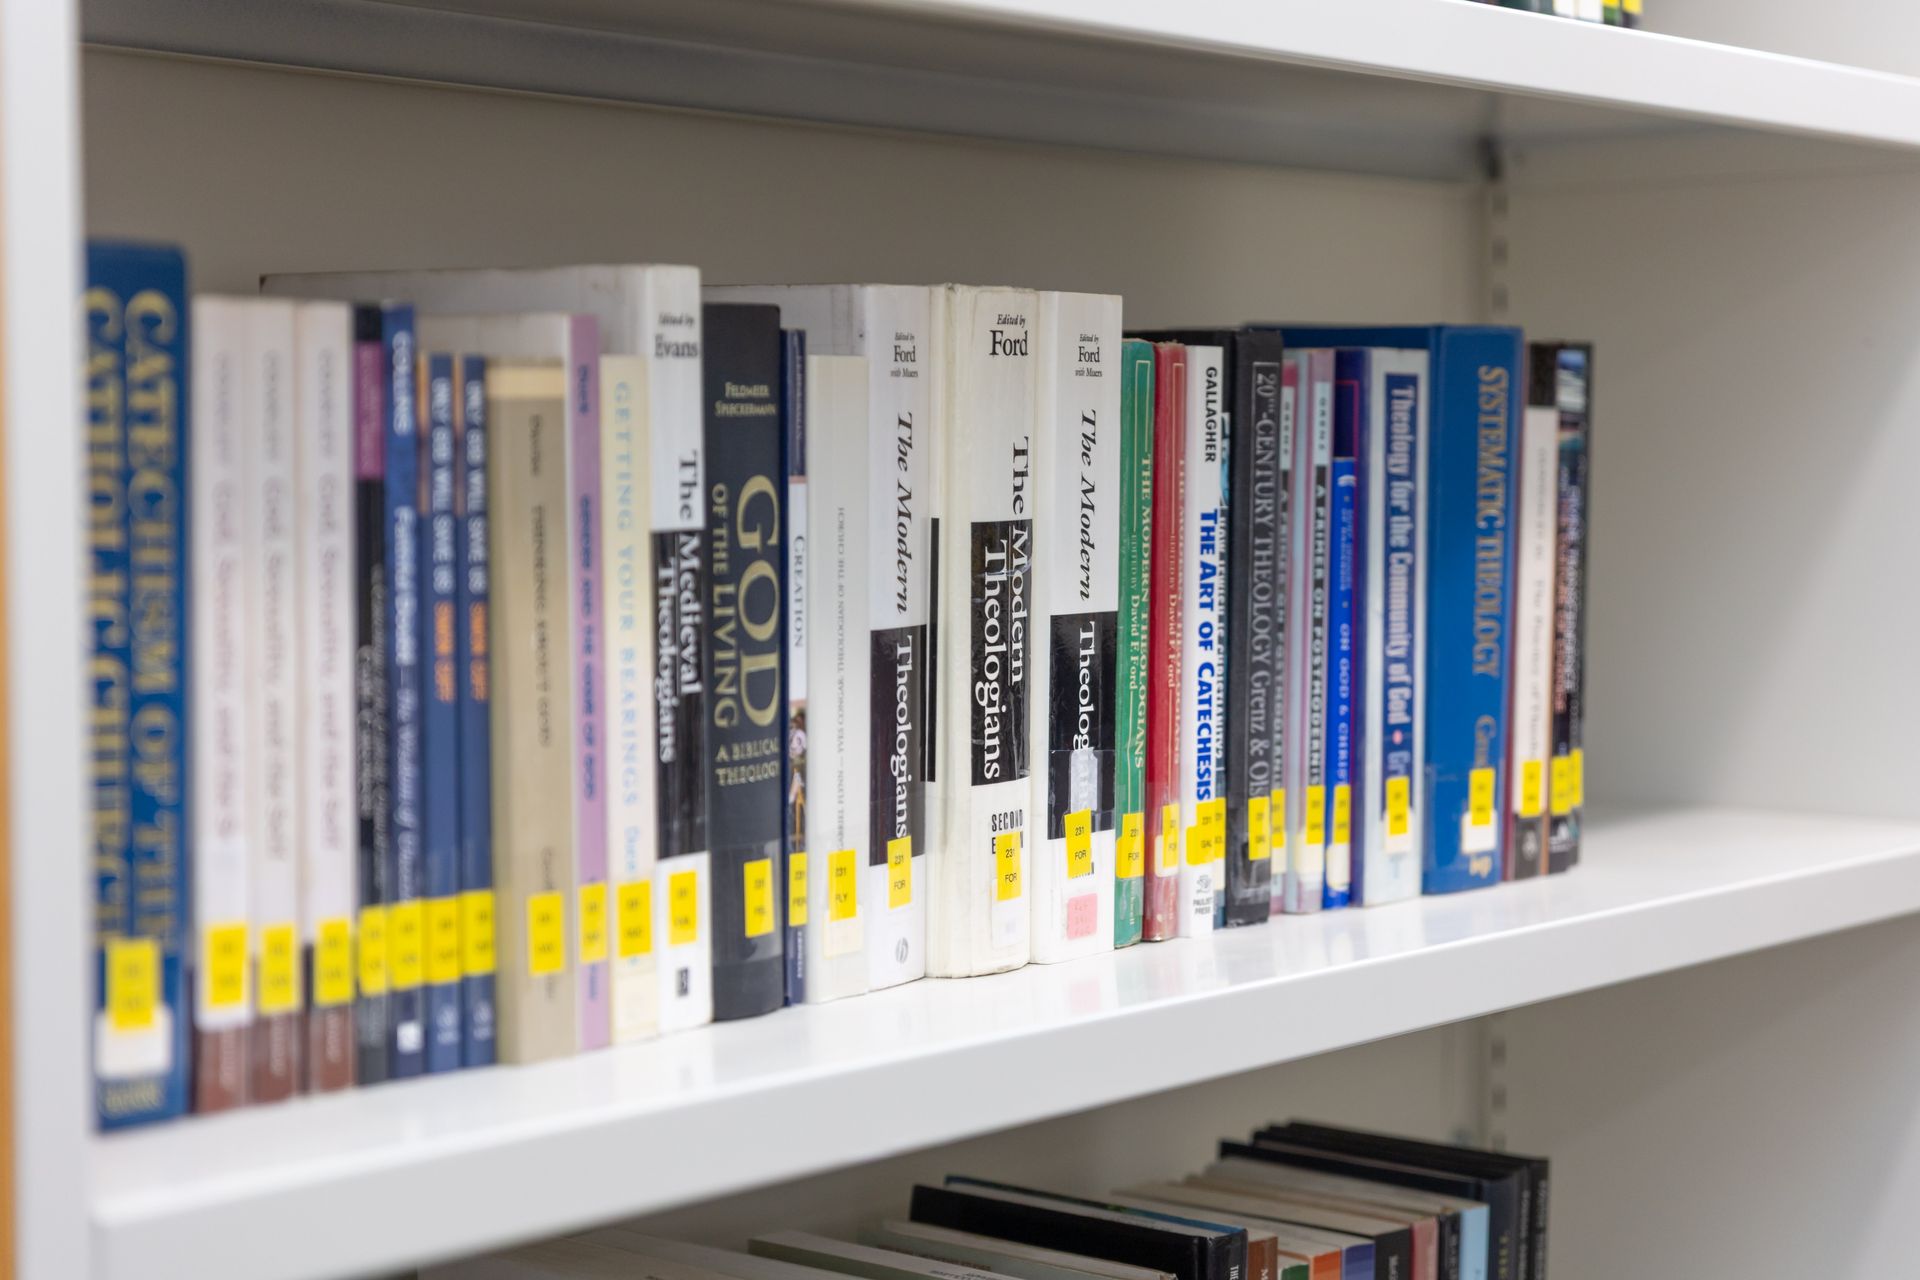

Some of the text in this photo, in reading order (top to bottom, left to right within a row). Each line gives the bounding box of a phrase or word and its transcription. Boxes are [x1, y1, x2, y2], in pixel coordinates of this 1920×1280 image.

[655, 333, 699, 359] Evans
[989, 330, 1029, 357] Ford
[996, 313, 1027, 329] Edited by
[893, 345, 917, 363] Ford
[1077, 345, 1101, 363] Ford
[1204, 365, 1219, 463] GALLAGHER
[1386, 385, 1416, 478] Theology
[1388, 480, 1414, 514] for
[1472, 365, 1510, 679] SYSTEMATIC THEOLOGY
[1388, 515, 1414, 549] the
[677, 450, 703, 697] The Medieval
[1011, 435, 1029, 686] The Modern
[614, 381, 640, 808] GETTING YOUR BEARINGS
[711, 482, 737, 748] OF THE LIVING
[736, 475, 781, 748] GOD
[792, 535, 806, 649] CREATION
[1073, 409, 1097, 790] The Modern Theolog
[1129, 594, 1141, 642] David
[1133, 453, 1152, 768] THE MODERN THEOLOGIANS
[1167, 593, 1179, 639] David
[1252, 534, 1278, 667] THEOLOGY
[1384, 552, 1414, 659] Community
[890, 411, 914, 839] The Modern Theologians
[1129, 643, 1140, 656] F.
[1309, 484, 1327, 786] A PRIMER ON POSTMODERNIS
[655, 556, 678, 764] Theologians
[975, 539, 1008, 781] Theologians
[1128, 656, 1140, 691] Ford
[1167, 656, 1178, 689] Ford
[1196, 508, 1218, 802] THE ART OF CATECHESIS
[1387, 662, 1413, 684] of
[1250, 670, 1272, 733] Grenz
[1274, 631, 1286, 790] POSTMODERNIS
[1386, 686, 1413, 726] God
[715, 736, 779, 763] A BIBLICAL
[1248, 738, 1270, 759] &
[1247, 761, 1271, 798] Ols
[991, 808, 1024, 832] SECOND
[1074, 826, 1085, 837] 231
[1074, 849, 1087, 861] FOR
